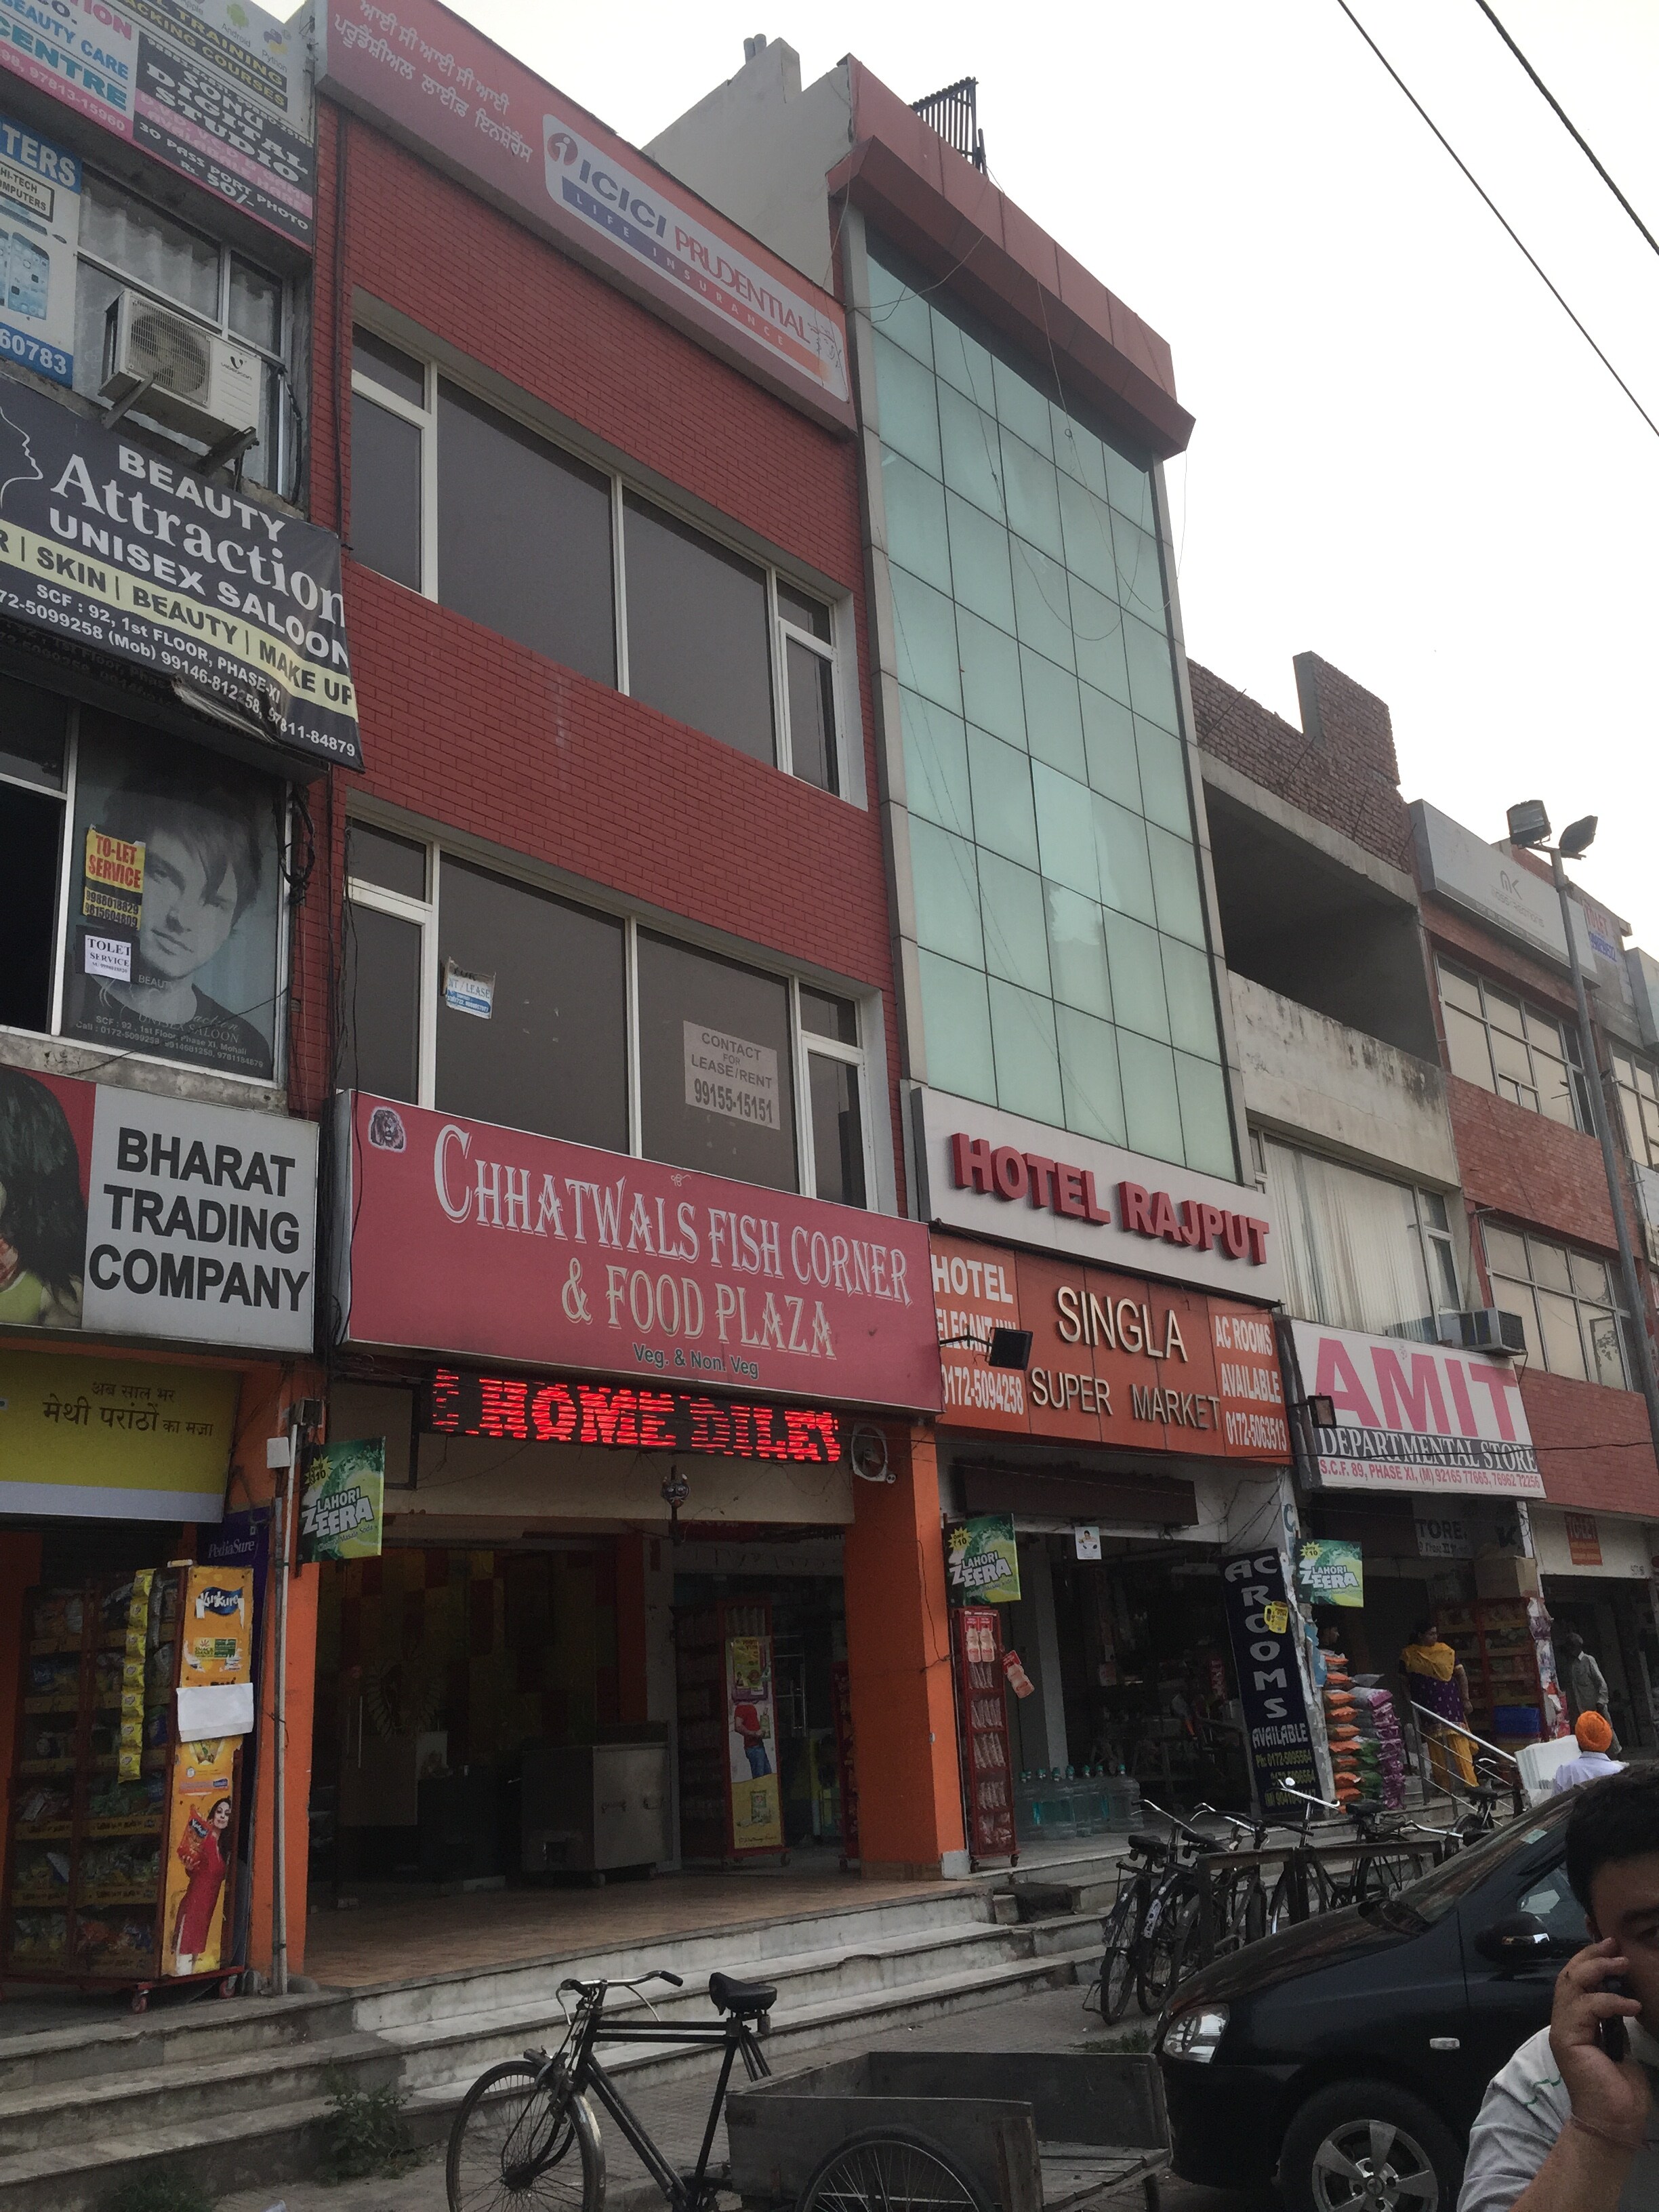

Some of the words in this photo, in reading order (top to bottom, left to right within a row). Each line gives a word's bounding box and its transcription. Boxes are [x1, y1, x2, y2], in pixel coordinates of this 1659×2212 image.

[71, 0, 132, 41] ION
[221, 23, 251, 47] Android
[81, 39, 129, 81] CARE
[176, 7, 283, 86] TRAINING
[262, 49, 288, 73] Python
[201, 46, 285, 106] COURSES
[29, 66, 125, 131] 97813-15960
[146, 62, 308, 176] DIGITAL
[183, 70, 264, 131] SONU
[155, 86, 299, 182] STUDIO
[0, 167, 38, 194] HI-TECH
[0, 180, 47, 212] MPUTERS
[140, 121, 161, 140] 30
[167, 138, 205, 168] PASS
[209, 165, 253, 194] PORT
[256, 193, 308, 230] PHOTO
[579, 159, 667, 239] ICICI
[576, 193, 630, 239] LIFE
[653, 245, 784, 346] INSURANCE
[674, 224, 811, 344] PRUDENTIAL
[118, 444, 287, 542] BEAUTY
[50, 453, 346, 628] Attraction
[49, 508, 205, 595] UNISEX
[218, 581, 350, 669] SALOON
[36, 583, 72, 607] SCF
[88, 605, 116, 628] 92,
[121, 617, 148, 638] 1st
[152, 628, 213, 668] FLOOR,
[37, 546, 106, 593] SKIN
[132, 585, 238, 644] BEAUTY
[260, 639, 316, 694] MAKE
[324, 678, 353, 705] UP
[108, 630, 156, 660] (Mob)
[96, 834, 137, 865] TO-LET
[88, 854, 142, 889] SERVICE
[87, 938, 130, 956] TOLET
[89, 952, 129, 967] SERVICE
[138, 974, 175, 989] BEAUT
[466, 983, 490, 999] LEASE
[75, 1020, 93, 1031] Call
[96, 1015, 114, 1025] SCF
[140, 1025, 153, 1036] 1st
[220, 1043, 247, 1055] Mohali
[701, 1032, 762, 1061] CONTACT
[722, 1052, 741, 1065] FOR
[691, 1054, 773, 1089] LEASE/RENT
[694, 1078, 773, 1124] 99155-15151
[117, 1126, 296, 1197] BHARAT
[103, 1184, 300, 1254] TRADING
[951, 1132, 1111, 1225] HOTEL
[1118, 1181, 1270, 1265] RAJPUT
[89, 1244, 310, 1312] COMPANY
[708, 1208, 785, 1279] FISH
[790, 1225, 914, 1308] CORNER
[930, 1252, 1013, 1305] HOTEL
[562, 1257, 593, 1325] &
[605, 1265, 704, 1340] FOOD
[716, 1283, 838, 1361] PLAZA
[1057, 1286, 1189, 1363] SINGLA
[1214, 1315, 1232, 1349] AC
[1234, 1319, 1273, 1356] ROOMS
[633, 1343, 669, 1367] Veg.
[674, 1349, 687, 1368] &
[729, 1355, 760, 1380] Veg
[91, 1382, 117, 1396] अब
[121, 1385, 150, 1400] साल
[157, 1387, 175, 1403] भर
[1031, 1367, 1113, 1416] SUPER
[1130, 1382, 1220, 1431] MARKET
[1221, 1362, 1282, 1404] AVAILABLE
[1314, 1336, 1518, 1442] AMIT
[42, 1393, 91, 1425] मेथी
[162, 1419, 180, 1433] का
[478, 1377, 676, 1448] HOME
[1225, 1413, 1287, 1452] 0172-5063513
[1319, 1427, 1479, 1467] DEPARTMENTAL
[1481, 1441, 1538, 1473] STORE
[1319, 1458, 1349, 1477] S.C.F.
[1351, 1462, 1368, 1481] 89,
[1369, 1464, 1401, 1481] PHASE
[1419, 1467, 1435, 1486] (M)
[1435, 1469, 1462, 1483] 92165
[302, 1497, 373, 1538] ZEERA
[317, 1487, 361, 1512] LAHORI
[949, 1558, 1012, 1588] ZEERA
[962, 1551, 998, 1570] LAHORI
[1225, 1555, 1279, 1583] AC
[1299, 1570, 1359, 1589] ZEERA
[1311, 1565, 1347, 1574] LAHORI
[1252, 1723, 1309, 1749] AVAILABLE
